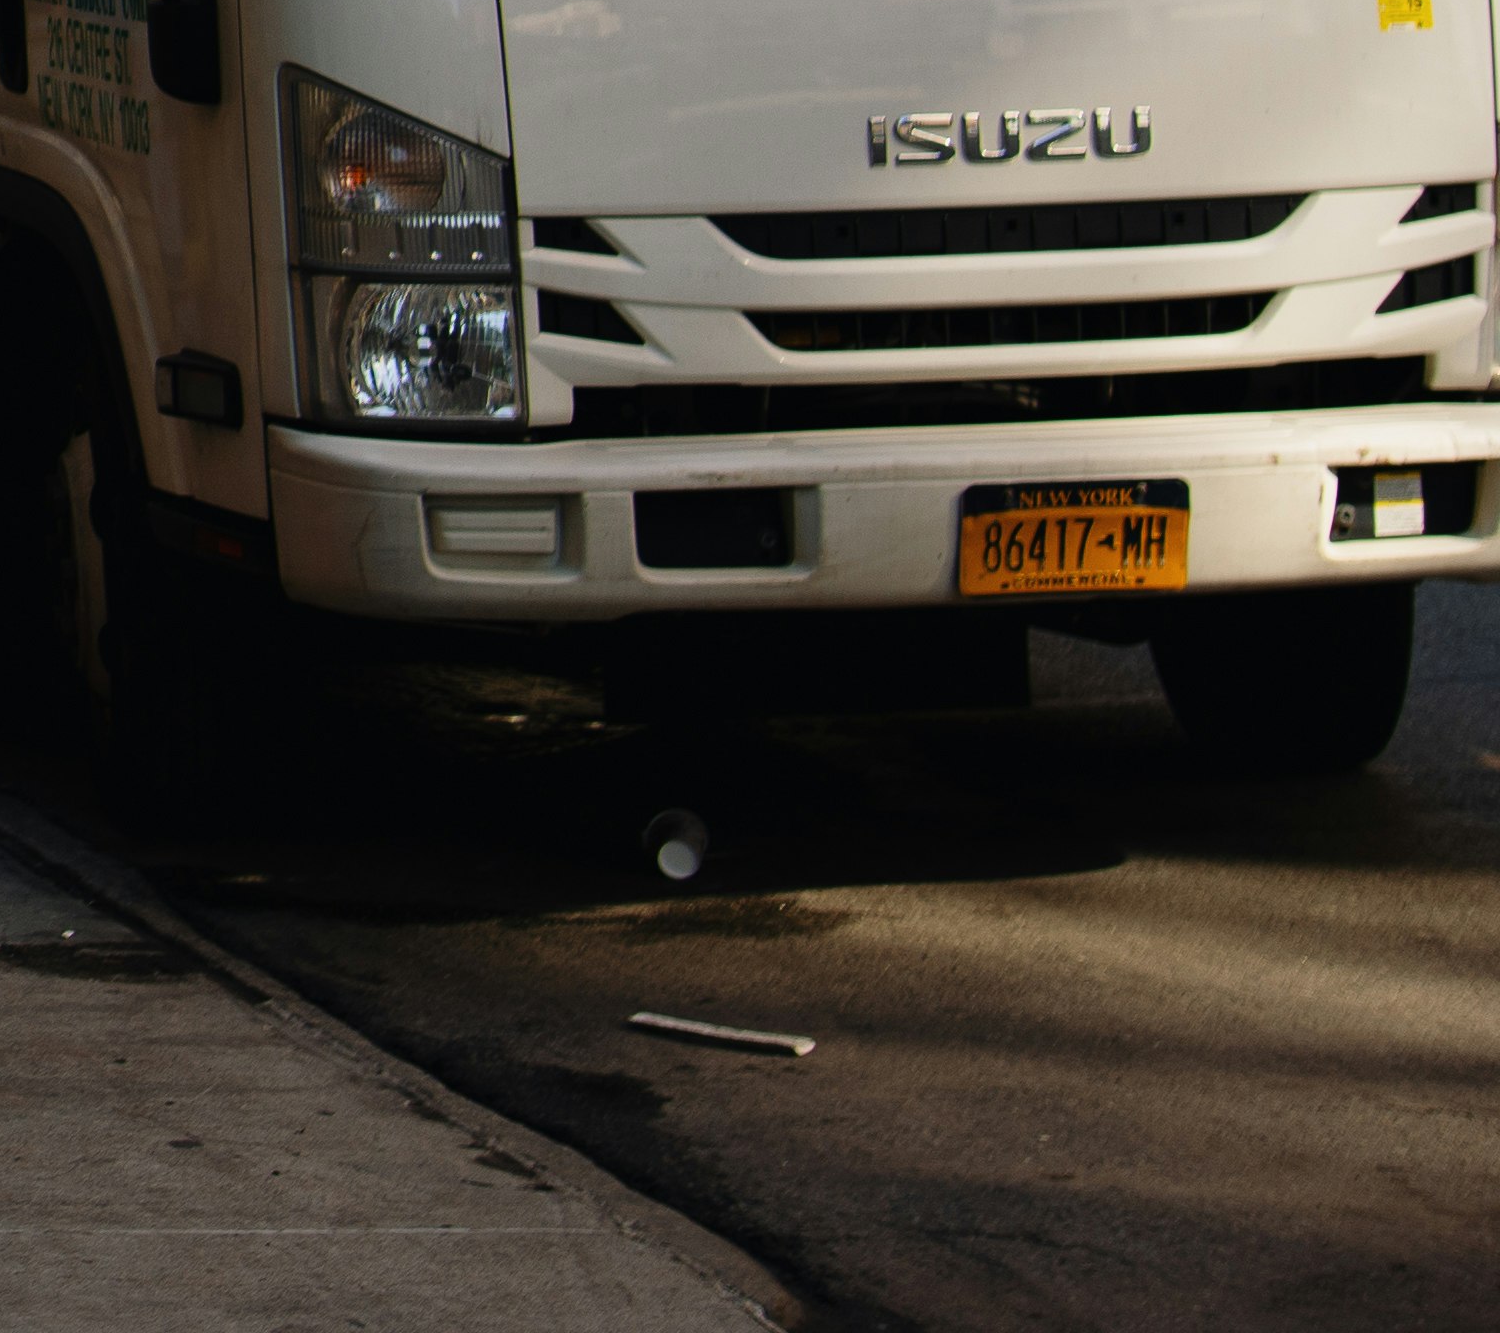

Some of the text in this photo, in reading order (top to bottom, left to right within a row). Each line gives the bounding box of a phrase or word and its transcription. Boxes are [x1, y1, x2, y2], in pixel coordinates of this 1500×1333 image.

[867, 104, 1154, 169] ISUZU
[1018, 486, 1135, 509] NEW YORK
[981, 515, 1169, 574] 86417 MH
